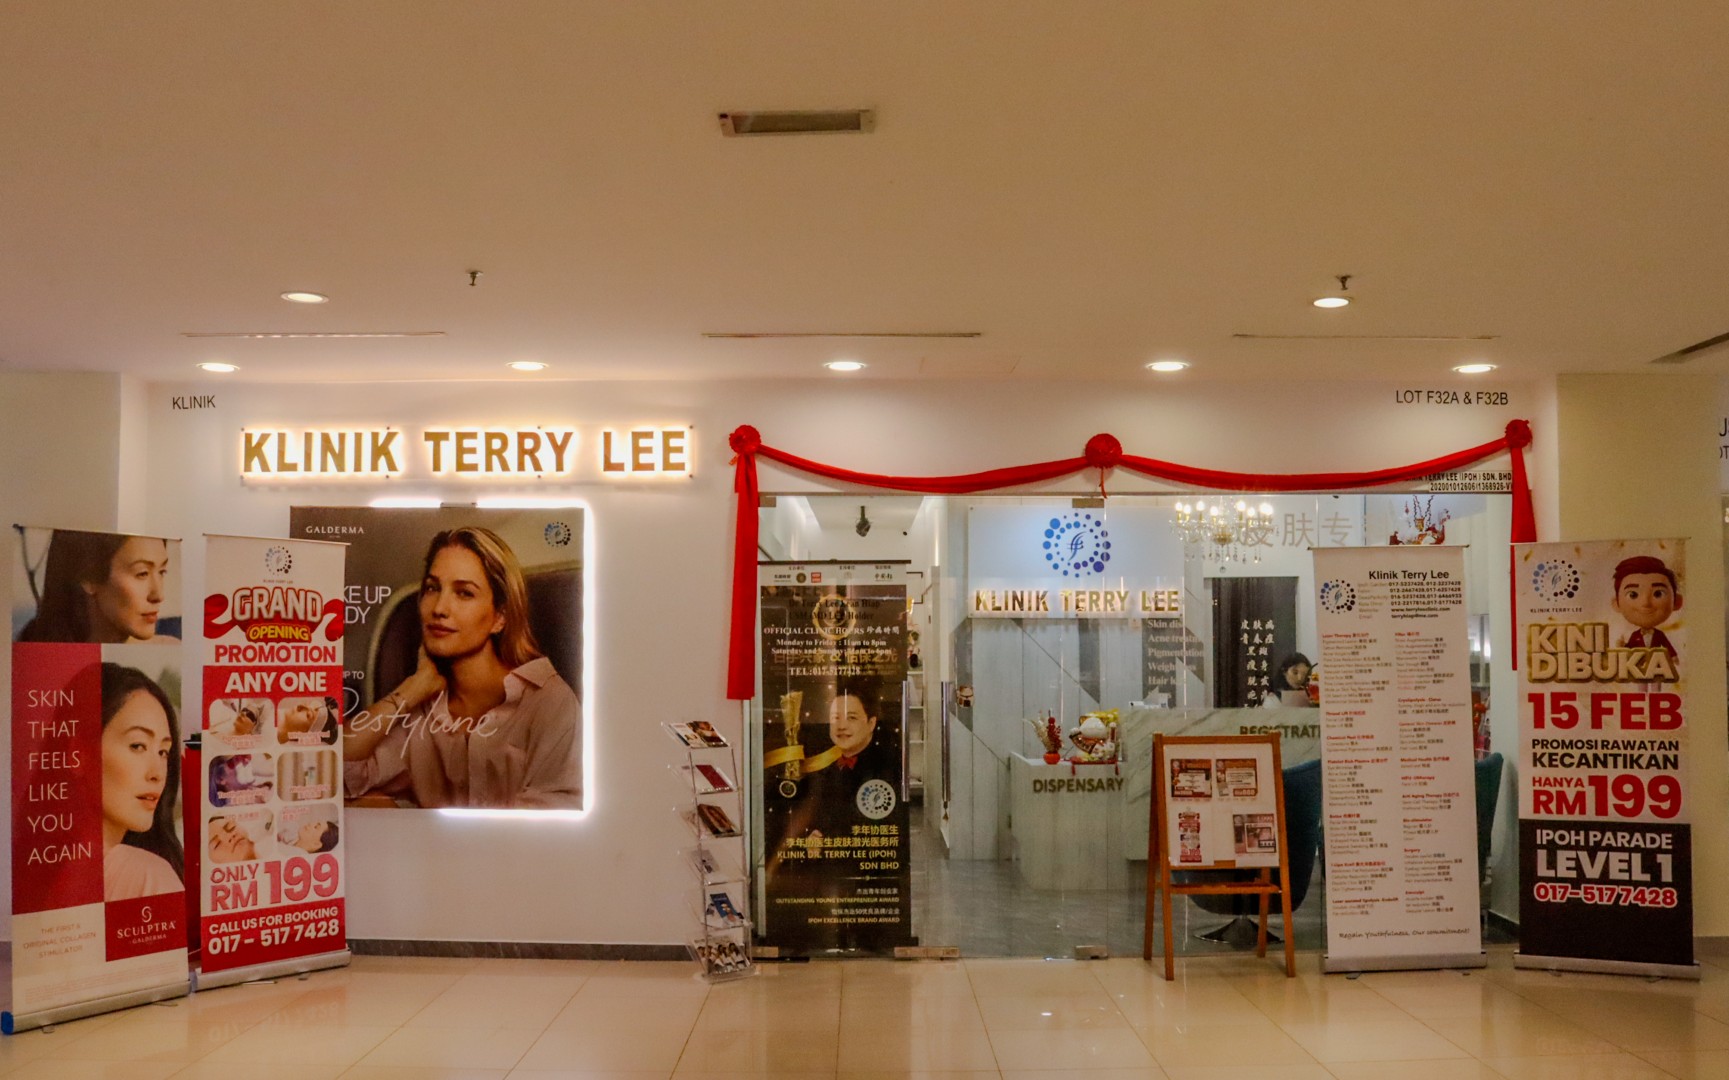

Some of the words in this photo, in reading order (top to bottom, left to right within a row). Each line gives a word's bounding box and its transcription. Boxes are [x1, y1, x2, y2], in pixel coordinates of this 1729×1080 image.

[172, 395, 216, 410] KLINIK
[1396, 390, 1422, 404] LOT
[1427, 390, 1459, 404] F32A
[1463, 391, 1472, 405] &
[1476, 391, 1509, 405] F32B
[243, 431, 400, 473] KLINIK
[424, 431, 574, 473] TERRY
[602, 430, 686, 472] LEE
[305, 525, 365, 534] GALDERMA
[1369, 571, 1398, 580] Klinik
[1401, 570, 1427, 581] Terry
[1431, 570, 1450, 579] Lee
[365, 585, 391, 605] UP
[974, 590, 1049, 612] KLINIK
[1061, 590, 1130, 612] TERRY
[1141, 590, 1179, 612] LEE
[233, 587, 323, 624] GRAND
[249, 625, 310, 641] OPENING
[763, 627, 802, 635] OFFICIAL
[1530, 625, 1606, 653] KINI
[776, 639, 804, 647] Monday
[871, 639, 887, 647] 8pm
[215, 645, 336, 663] PROMOTION
[352, 671, 364, 680] TO
[1530, 651, 1675, 680] DIBUKA
[225, 671, 277, 693] ANY
[279, 671, 327, 692] ONE
[28, 689, 74, 708] SKIN
[1528, 692, 1579, 729] 15
[1591, 692, 1683, 730] FEB
[28, 720, 80, 739] THAT
[1532, 739, 1598, 750] PROMOSI
[1601, 739, 1679, 751] RAWATAN
[28, 750, 81, 770] FEELS
[1532, 752, 1679, 770] KECANTIKAN
[28, 782, 69, 802] LIKE
[1033, 777, 1124, 793] DISPENSARY
[1532, 777, 1585, 788] HANYA
[1532, 790, 1587, 816] RM
[1588, 774, 1682, 819] 199
[28, 813, 73, 833] YOU
[1536, 829, 1585, 846] IPOH
[1589, 830, 1673, 849] PARADE
[28, 842, 92, 865] AGAIN
[777, 850, 805, 859] KLINIK
[807, 850, 822, 859] DR.
[825, 850, 851, 858] TERRY
[853, 850, 867, 858] LEE
[869, 850, 897, 859] (IPOH)
[210, 863, 259, 884] ONLY
[859, 861, 879, 870] SDN
[880, 861, 899, 870] BHD
[1536, 849, 1651, 882] LEVEL
[1656, 853, 1673, 882] 1
[211, 880, 258, 912] RM
[264, 853, 339, 904] 199
[209, 920, 240, 935] CALL
[242, 918, 257, 930] US
[259, 914, 282, 927] FOR
[284, 906, 338, 924] BOOKING
[132, 933, 167, 945] GALDERMA
[208, 934, 241, 955] 017
[260, 926, 290, 947] 517
[294, 919, 339, 942] 7428
